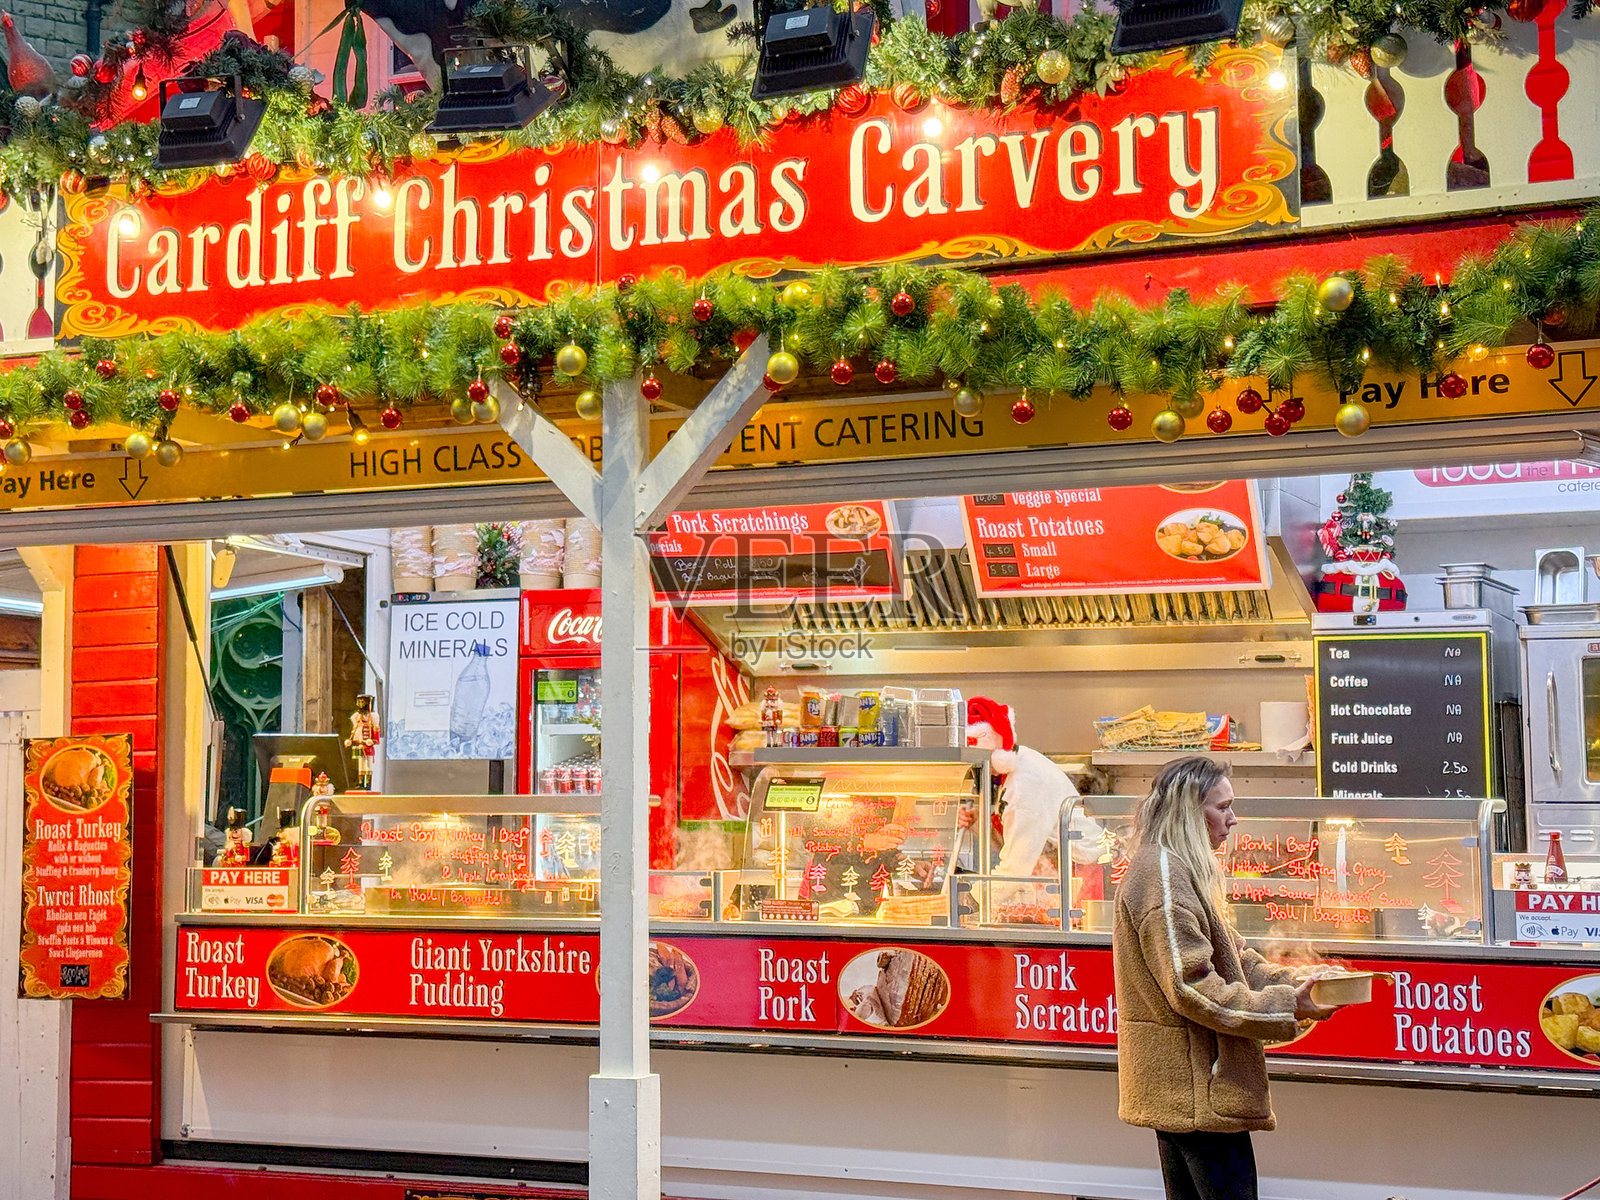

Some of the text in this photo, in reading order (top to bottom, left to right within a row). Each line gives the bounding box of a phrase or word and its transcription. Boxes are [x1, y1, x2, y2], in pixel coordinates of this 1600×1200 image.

[105, 107, 1219, 299] Cardiff Christmas Carvery
[1340, 372, 1510, 409] Pay Hre
[813, 408, 985, 447] CATERING
[350, 440, 522, 478] HIGH CLASS
[1526, 464, 1548, 477] the
[0, 470, 95, 499] ay Here
[1011, 490, 1052, 508] Veggie
[1054, 488, 1103, 507] Special
[672, 509, 809, 536] Pork Scratchings
[975, 515, 1105, 539] Roast Potatoes
[649, 539, 683, 556] pecials
[1021, 541, 1057, 558] Small
[1025, 562, 1061, 580] Large
[404, 610, 505, 632] ICE COLD
[399, 638, 509, 660] MINERALS
[1329, 647, 1461, 659] Tea NA
[1330, 674, 1462, 687] Coffee NA
[1331, 703, 1462, 716] Hot Chocolate NA
[1331, 732, 1463, 745] Fruit Juice NA
[1332, 760, 1469, 775] Cold Drinks 2.50
[1333, 789, 1384, 798] Minerals
[35, 815, 121, 843] Roast Turkey
[358, 821, 404, 842] Roast
[499, 827, 531, 848] Beef
[1241, 833, 1273, 852] Pork
[1285, 835, 1320, 857] Beef
[492, 848, 500, 861] &
[501, 849, 527, 869] Gravy
[210, 871, 280, 884] PAY HERE
[1287, 860, 1338, 883] Stuffing
[1352, 861, 1387, 886] Gravy
[79, 884, 115, 906] Rhost
[245, 896, 264, 905] VISA
[1231, 881, 1242, 900] &
[1244, 882, 1275, 902] Apple
[1278, 883, 1315, 900] Sauce
[1528, 894, 1600, 911] PAY H
[1264, 901, 1371, 929] Roll Baguette
[1561, 926, 1600, 940] Pay VI
[186, 932, 245, 964] Roast
[410, 936, 591, 975] Giant Yorkshire
[758, 948, 830, 984] Roast
[1013, 950, 1078, 991] Pork
[186, 964, 260, 1007] Turkey
[409, 971, 505, 1017] Pudding
[1391, 971, 1484, 1013] Roast
[758, 984, 817, 1022] Pork
[1393, 1013, 1532, 1058] Potatoes
